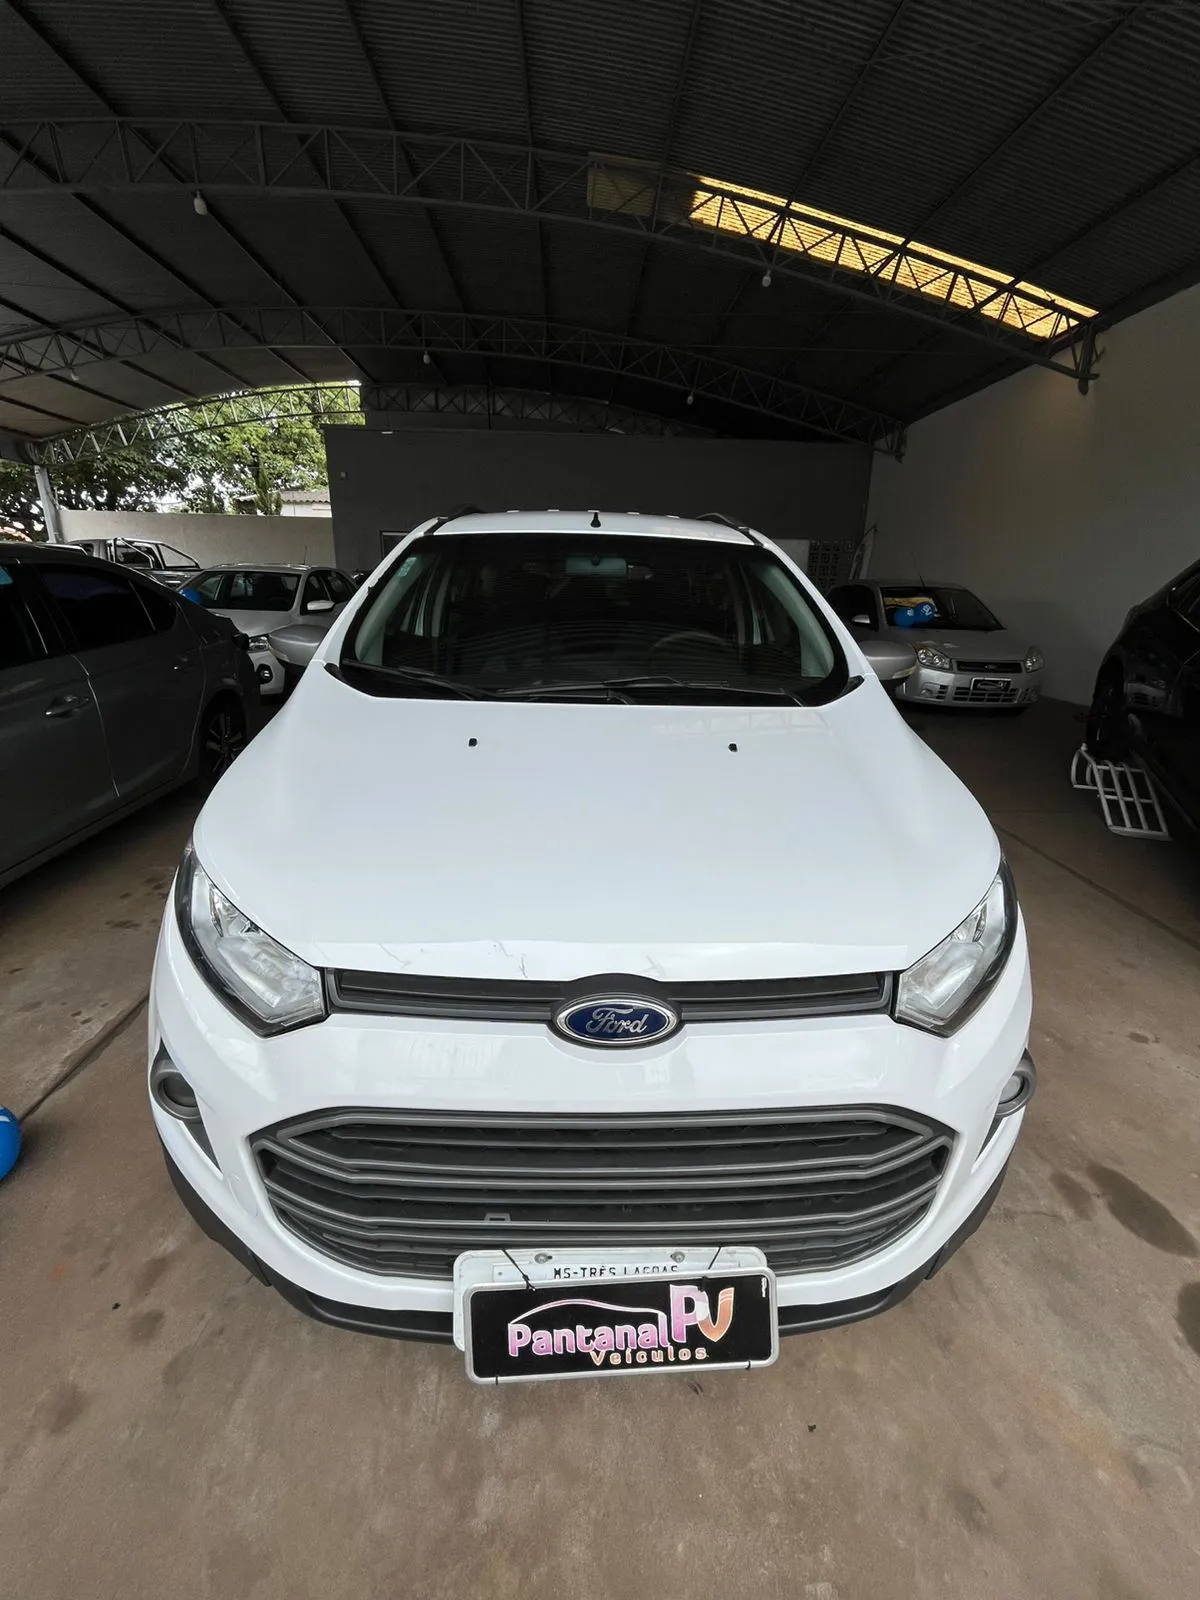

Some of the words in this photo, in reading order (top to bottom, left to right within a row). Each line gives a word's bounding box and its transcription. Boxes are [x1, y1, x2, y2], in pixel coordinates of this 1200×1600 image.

[585, 1007, 649, 1034] Ford
[508, 1311, 670, 1357] Pantanal
[669, 1284, 734, 1343] PV
